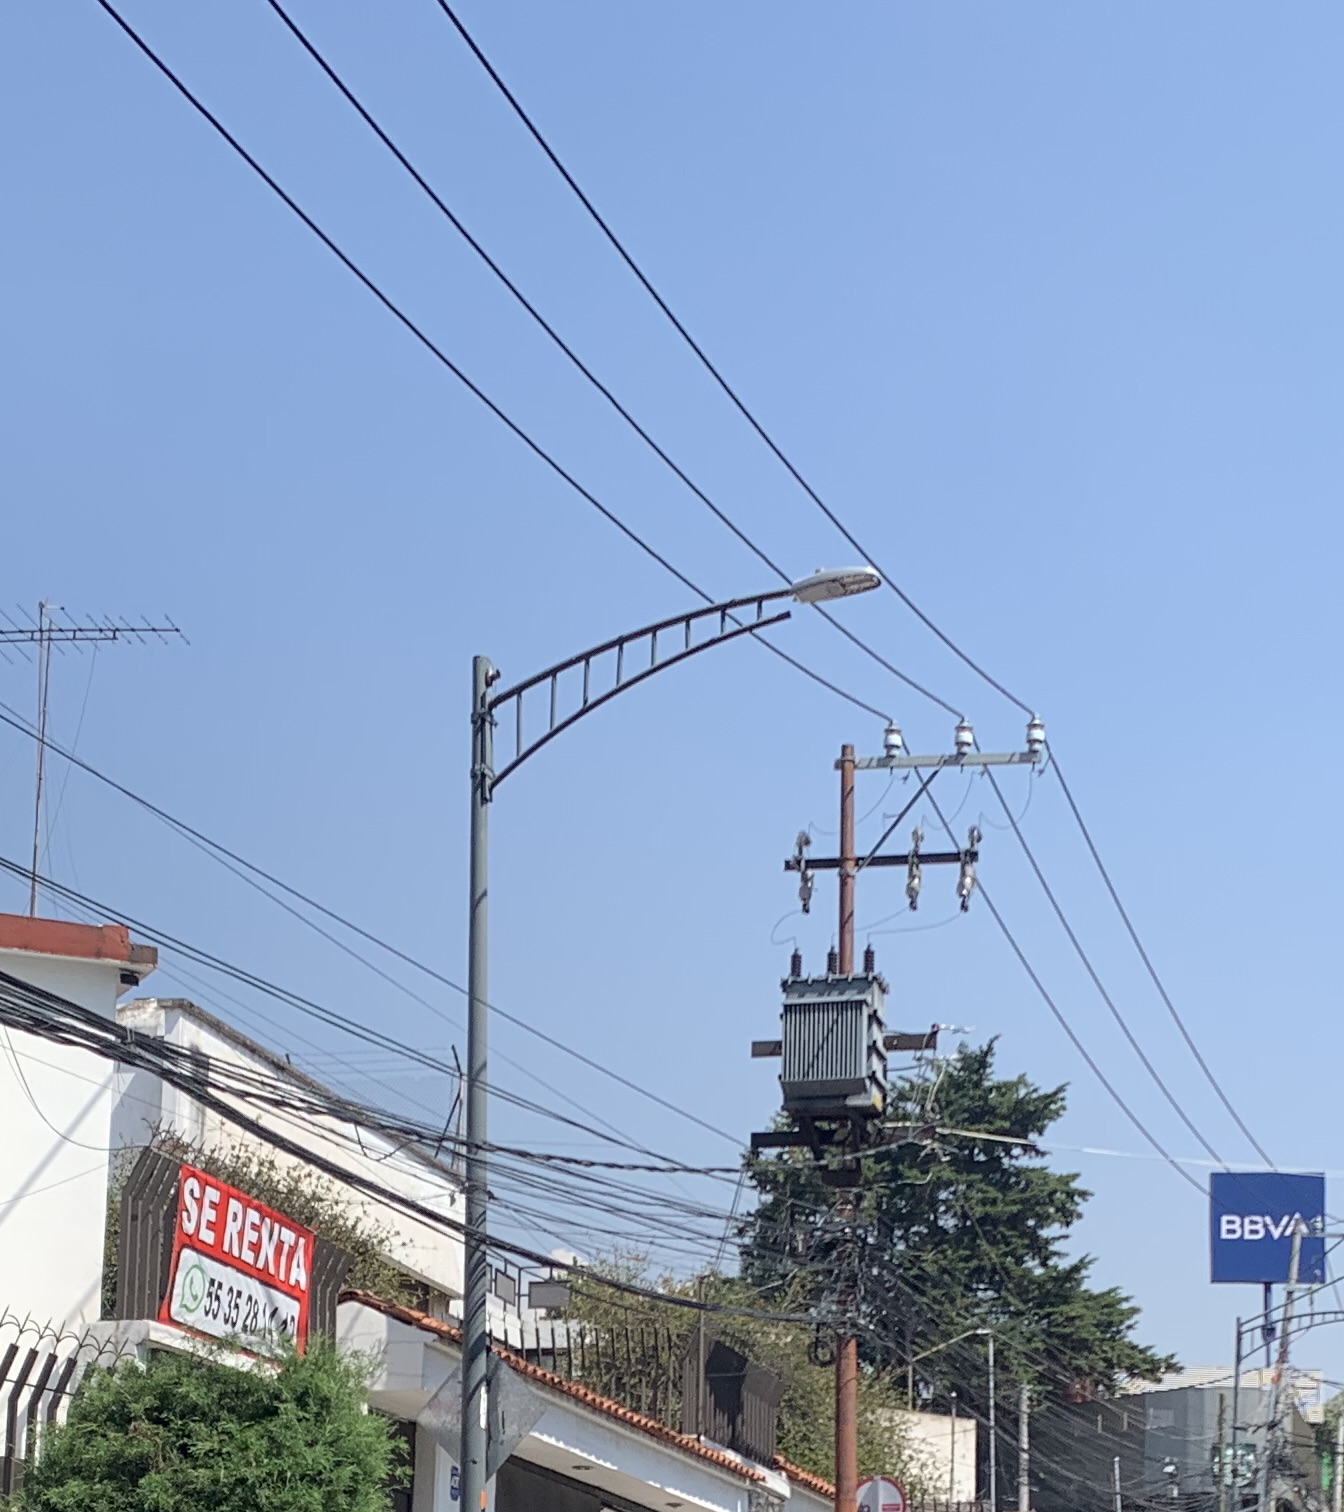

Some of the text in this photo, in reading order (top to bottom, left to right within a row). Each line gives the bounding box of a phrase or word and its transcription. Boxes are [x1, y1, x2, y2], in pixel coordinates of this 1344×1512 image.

[182, 1176, 308, 1292] SE RENTA
[1220, 1212, 1309, 1240] BBVA
[204, 1278, 223, 1320] 55
[223, 1285, 243, 1329] 35
[241, 1294, 259, 1335] 28
